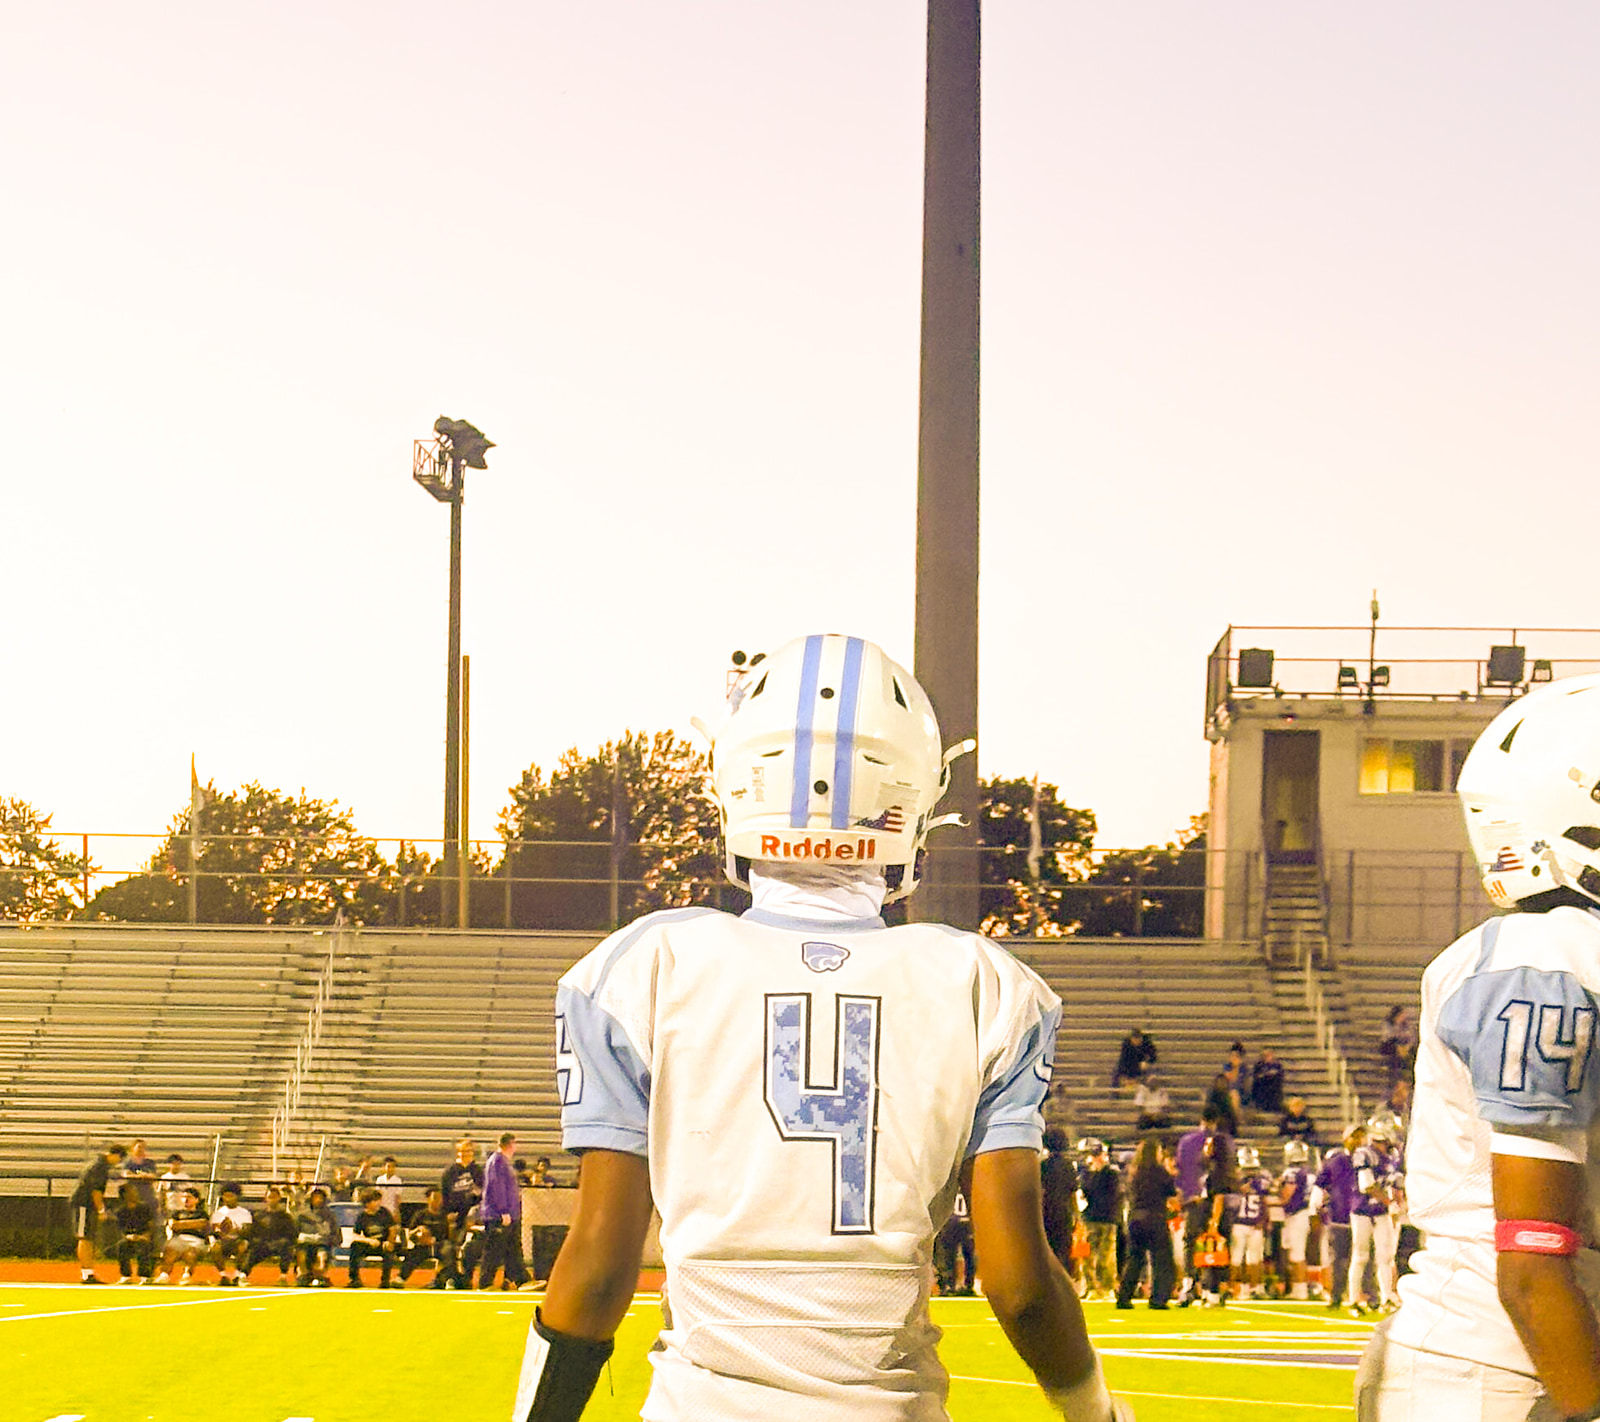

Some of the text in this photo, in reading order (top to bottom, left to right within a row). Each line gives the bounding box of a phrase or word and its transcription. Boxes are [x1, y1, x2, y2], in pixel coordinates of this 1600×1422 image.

[761, 834, 876, 860] Riddell
[1497, 997, 1598, 1095] 14
[763, 992, 882, 1236] 4
[1238, 1194, 1261, 1219] 15
